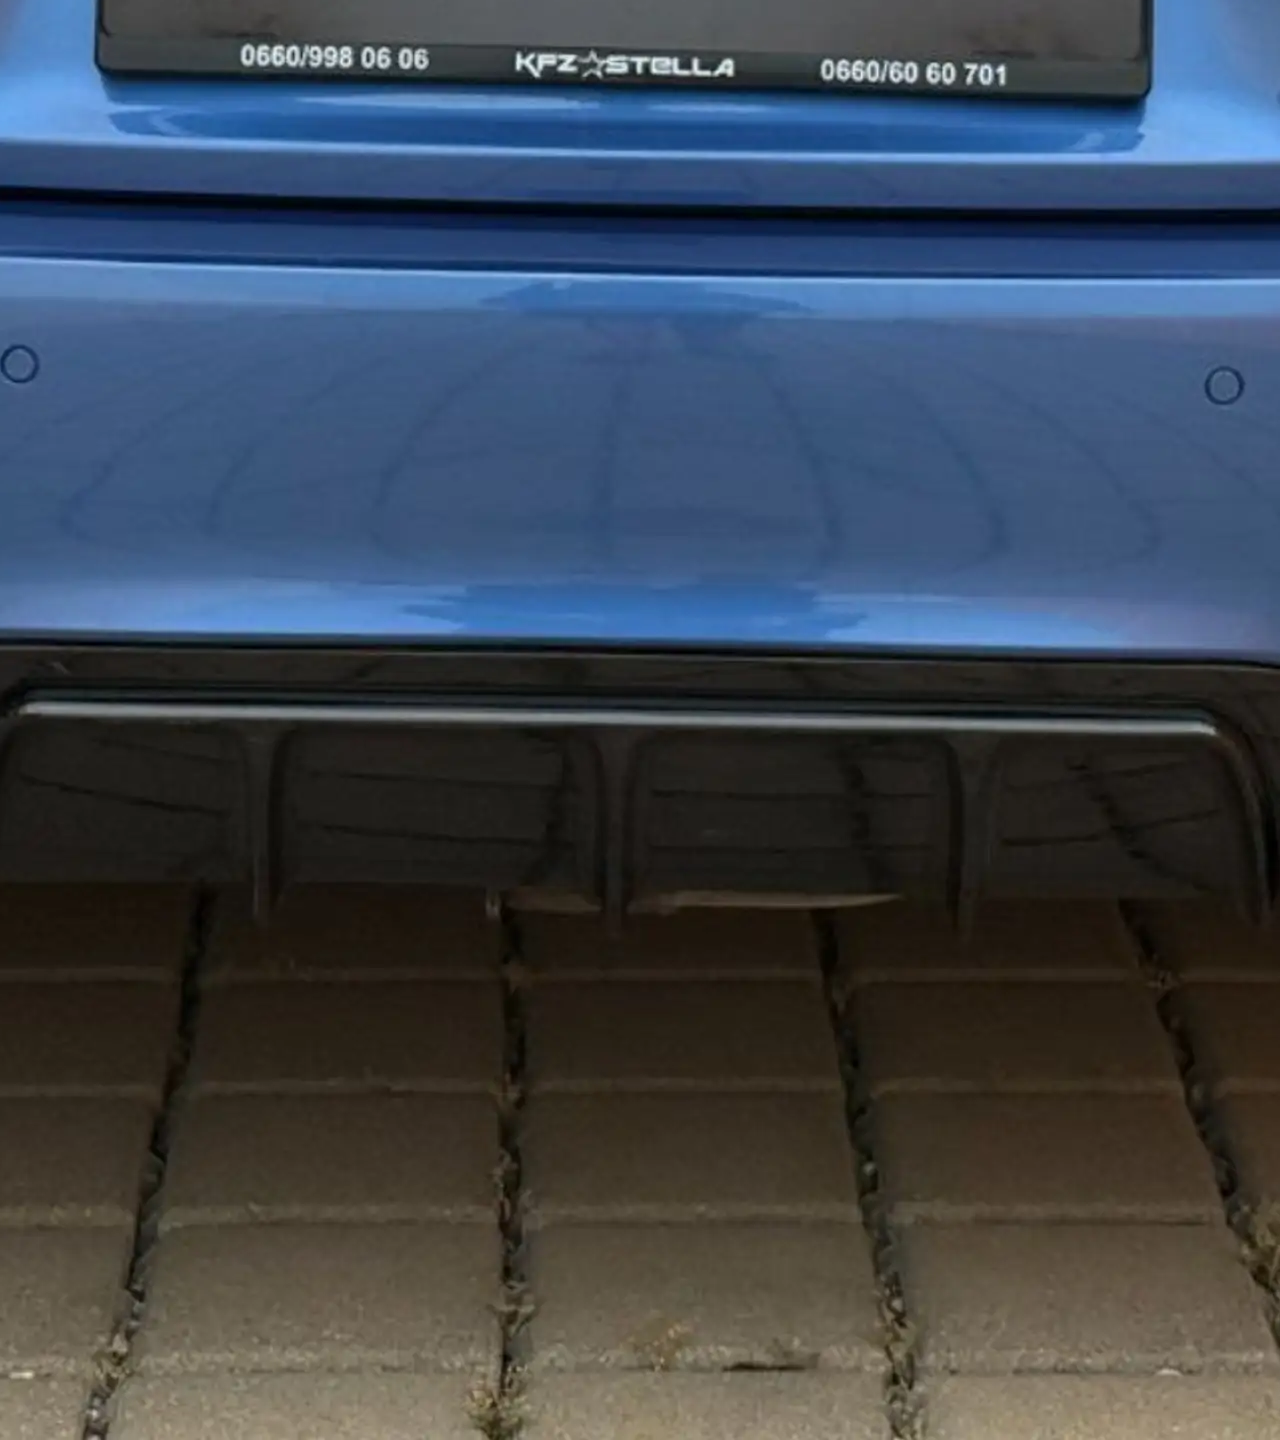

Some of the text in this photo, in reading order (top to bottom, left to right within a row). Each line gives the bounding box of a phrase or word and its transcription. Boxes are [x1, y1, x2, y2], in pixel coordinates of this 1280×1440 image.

[240, 43, 430, 71] 0660/998 06 06
[515, 50, 579, 78] KFZ
[820, 58, 1007, 87] 0660/60 60 701
